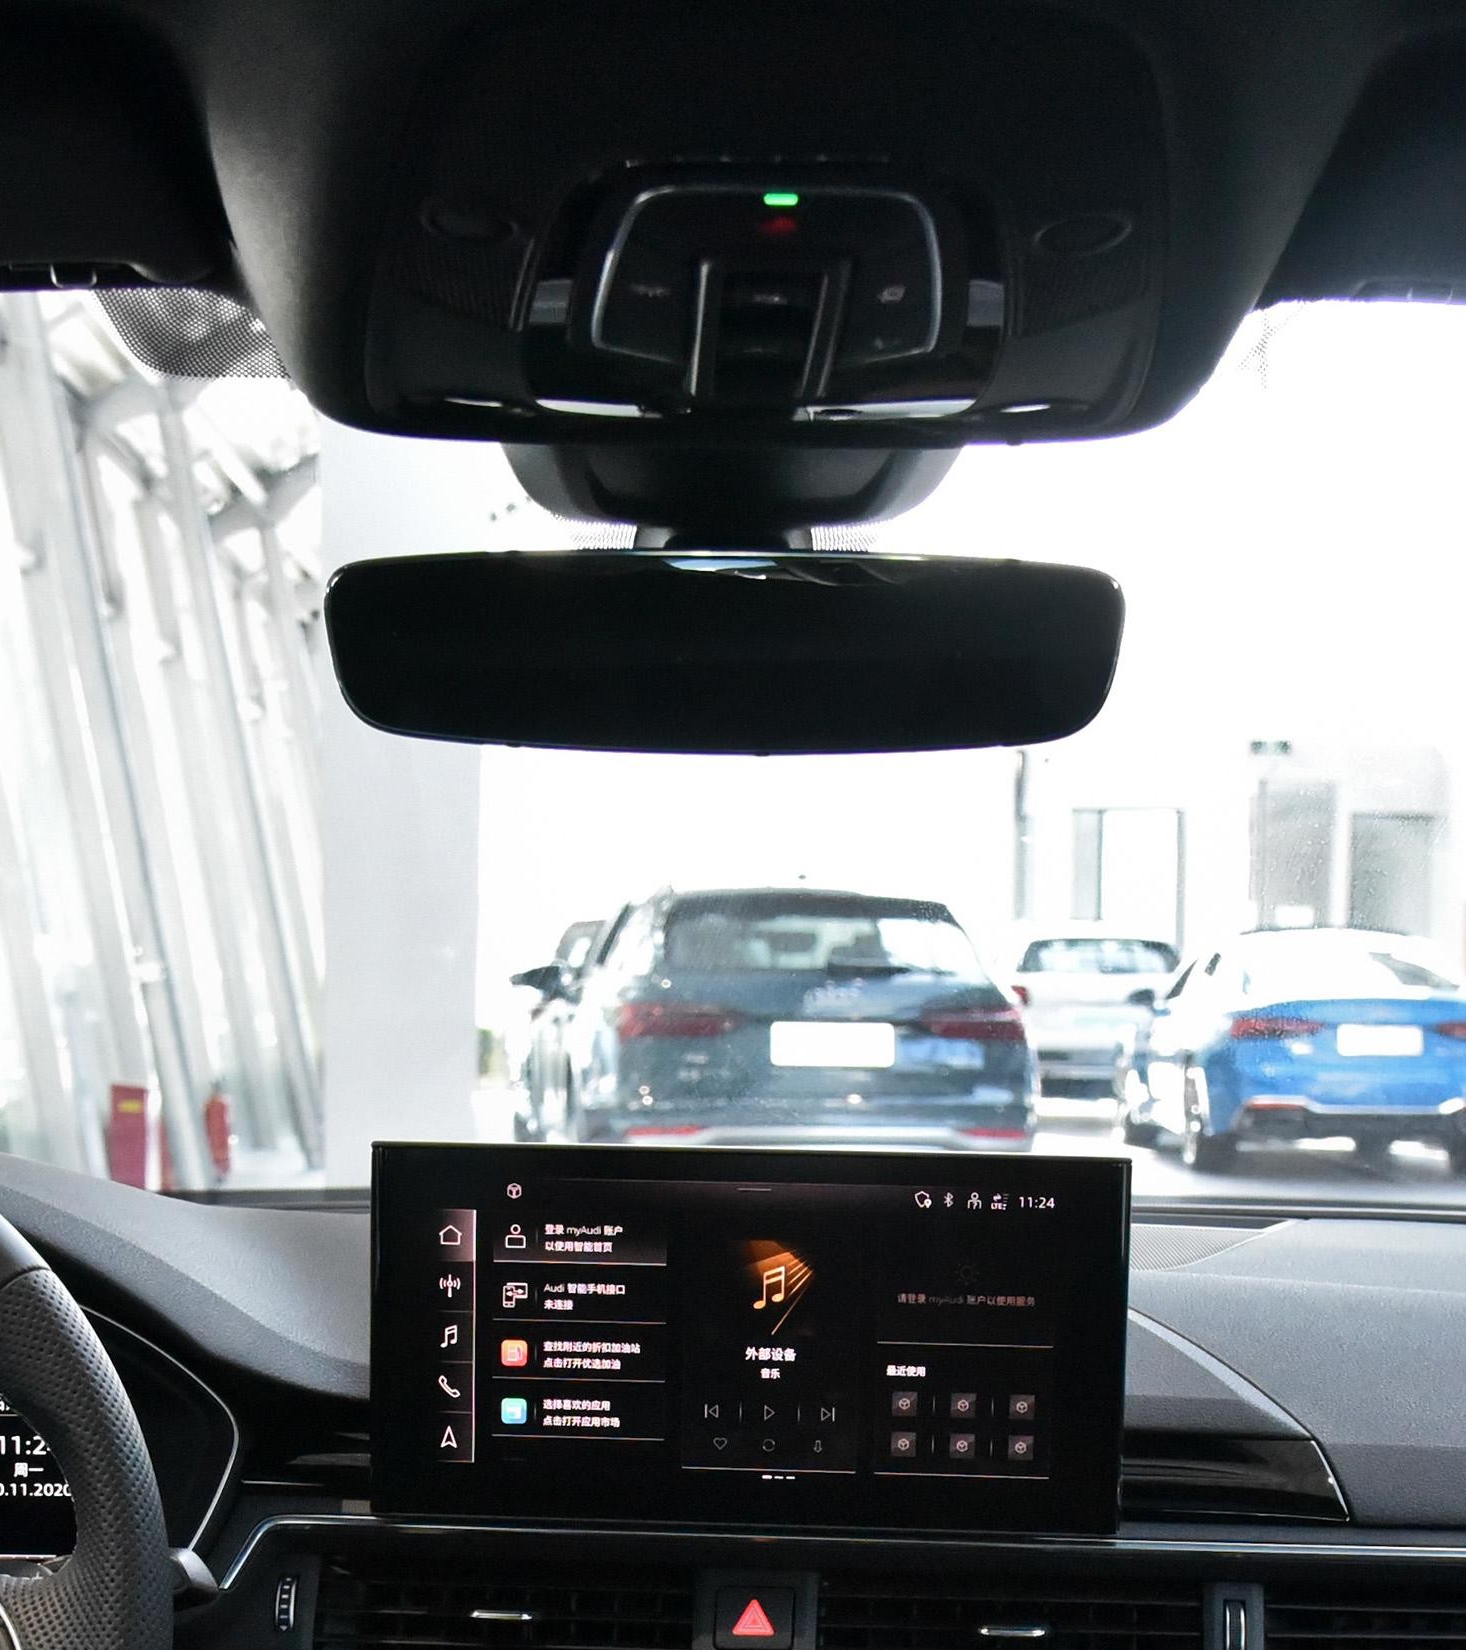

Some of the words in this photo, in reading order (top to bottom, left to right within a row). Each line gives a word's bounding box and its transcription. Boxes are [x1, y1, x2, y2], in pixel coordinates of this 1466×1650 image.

[1018, 1196, 1055, 1209] 11:24
[566, 1225, 602, 1238] myAudi
[543, 1283, 565, 1293] Audi
[744, 1346, 797, 1362] 外部设备
[760, 1368, 781, 1380] 音乐
[13, 1462, 45, 1478] 周一
